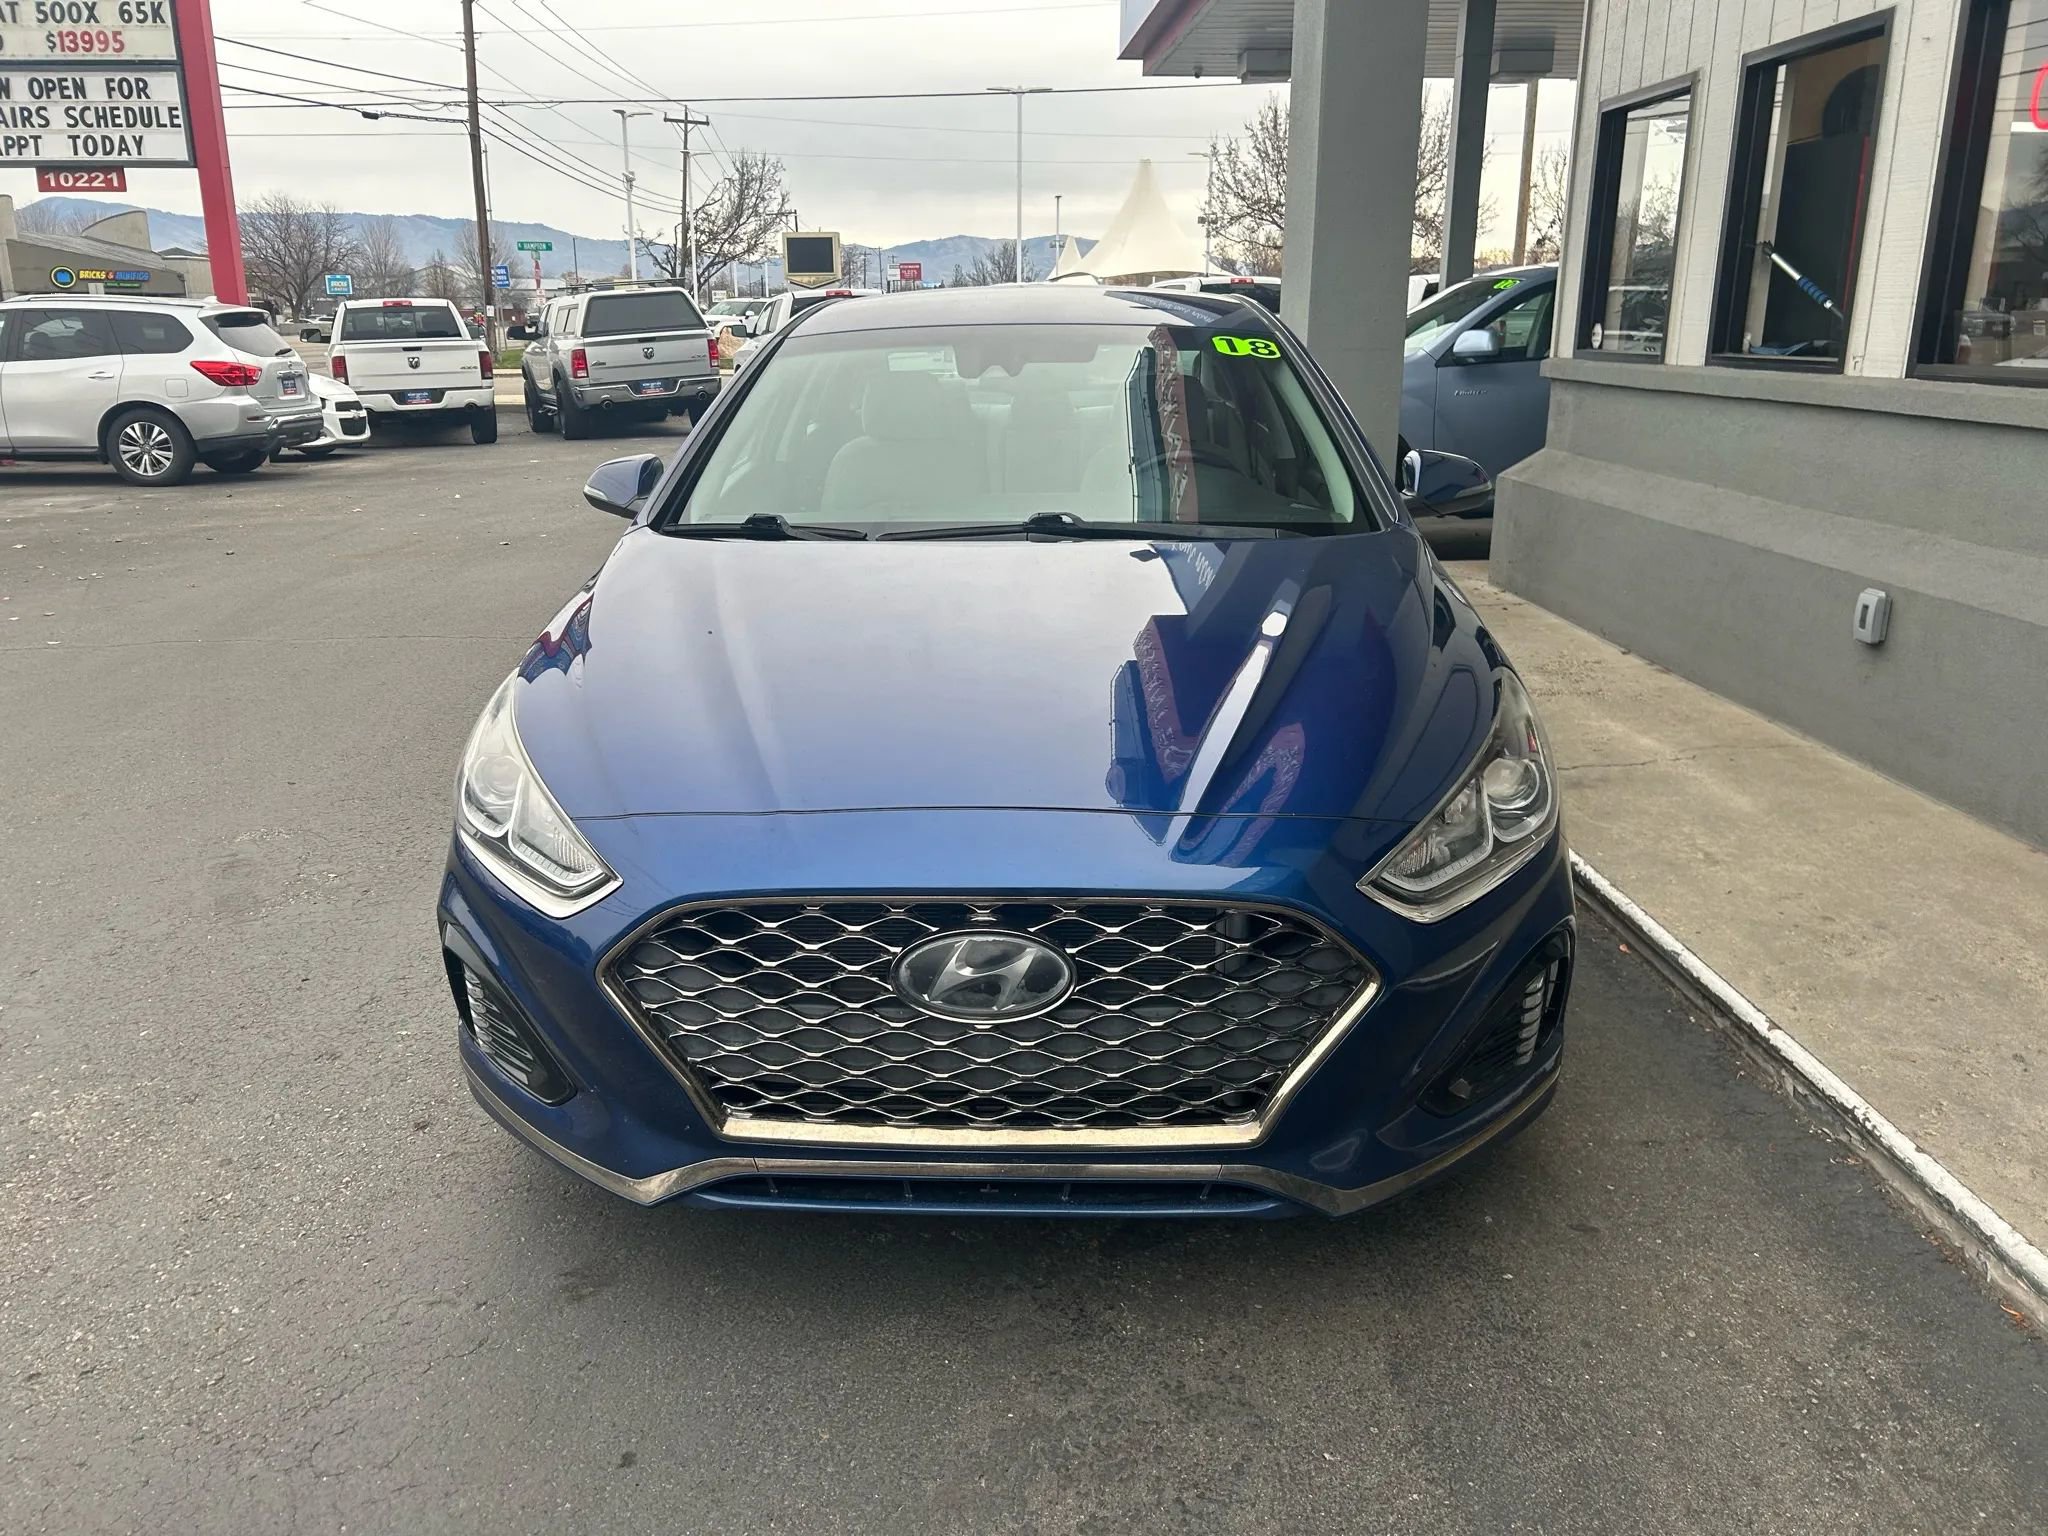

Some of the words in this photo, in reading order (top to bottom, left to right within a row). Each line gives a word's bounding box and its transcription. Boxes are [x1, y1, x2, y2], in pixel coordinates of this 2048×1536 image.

[35, 1, 101, 24] 500X
[117, 1, 166, 24] 65K
[45, 30, 125, 53] $13995
[27, 77, 88, 100] OPEN
[104, 77, 151, 100] FOR
[63, 106, 182, 128] SCHEDULE
[0, 135, 42, 157] PPT
[67, 134, 144, 156] TODAY
[43, 172, 120, 188] 10221
[79, 270, 106, 279] BRICKS
[1216, 336, 1279, 358] 18
